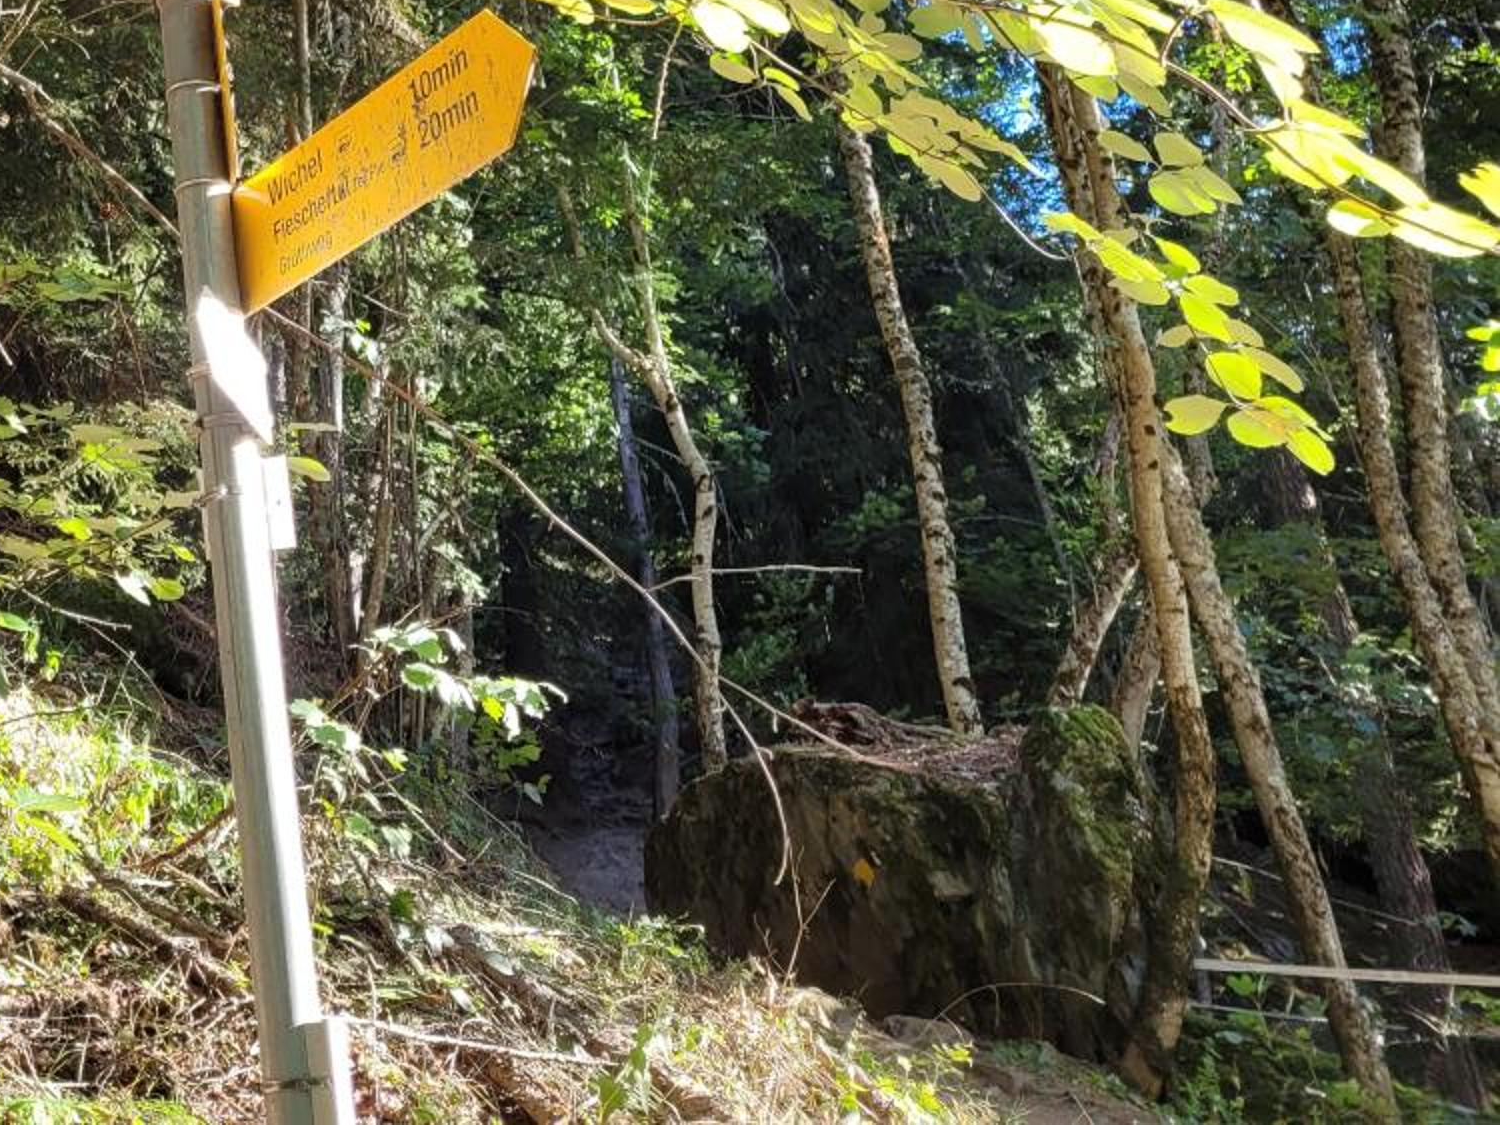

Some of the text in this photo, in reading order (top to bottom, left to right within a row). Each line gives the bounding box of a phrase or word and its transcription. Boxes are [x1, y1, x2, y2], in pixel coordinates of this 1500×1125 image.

[266, 149, 323, 206] Wichel
[408, 49, 468, 103] 10min
[418, 91, 479, 149] 20min
